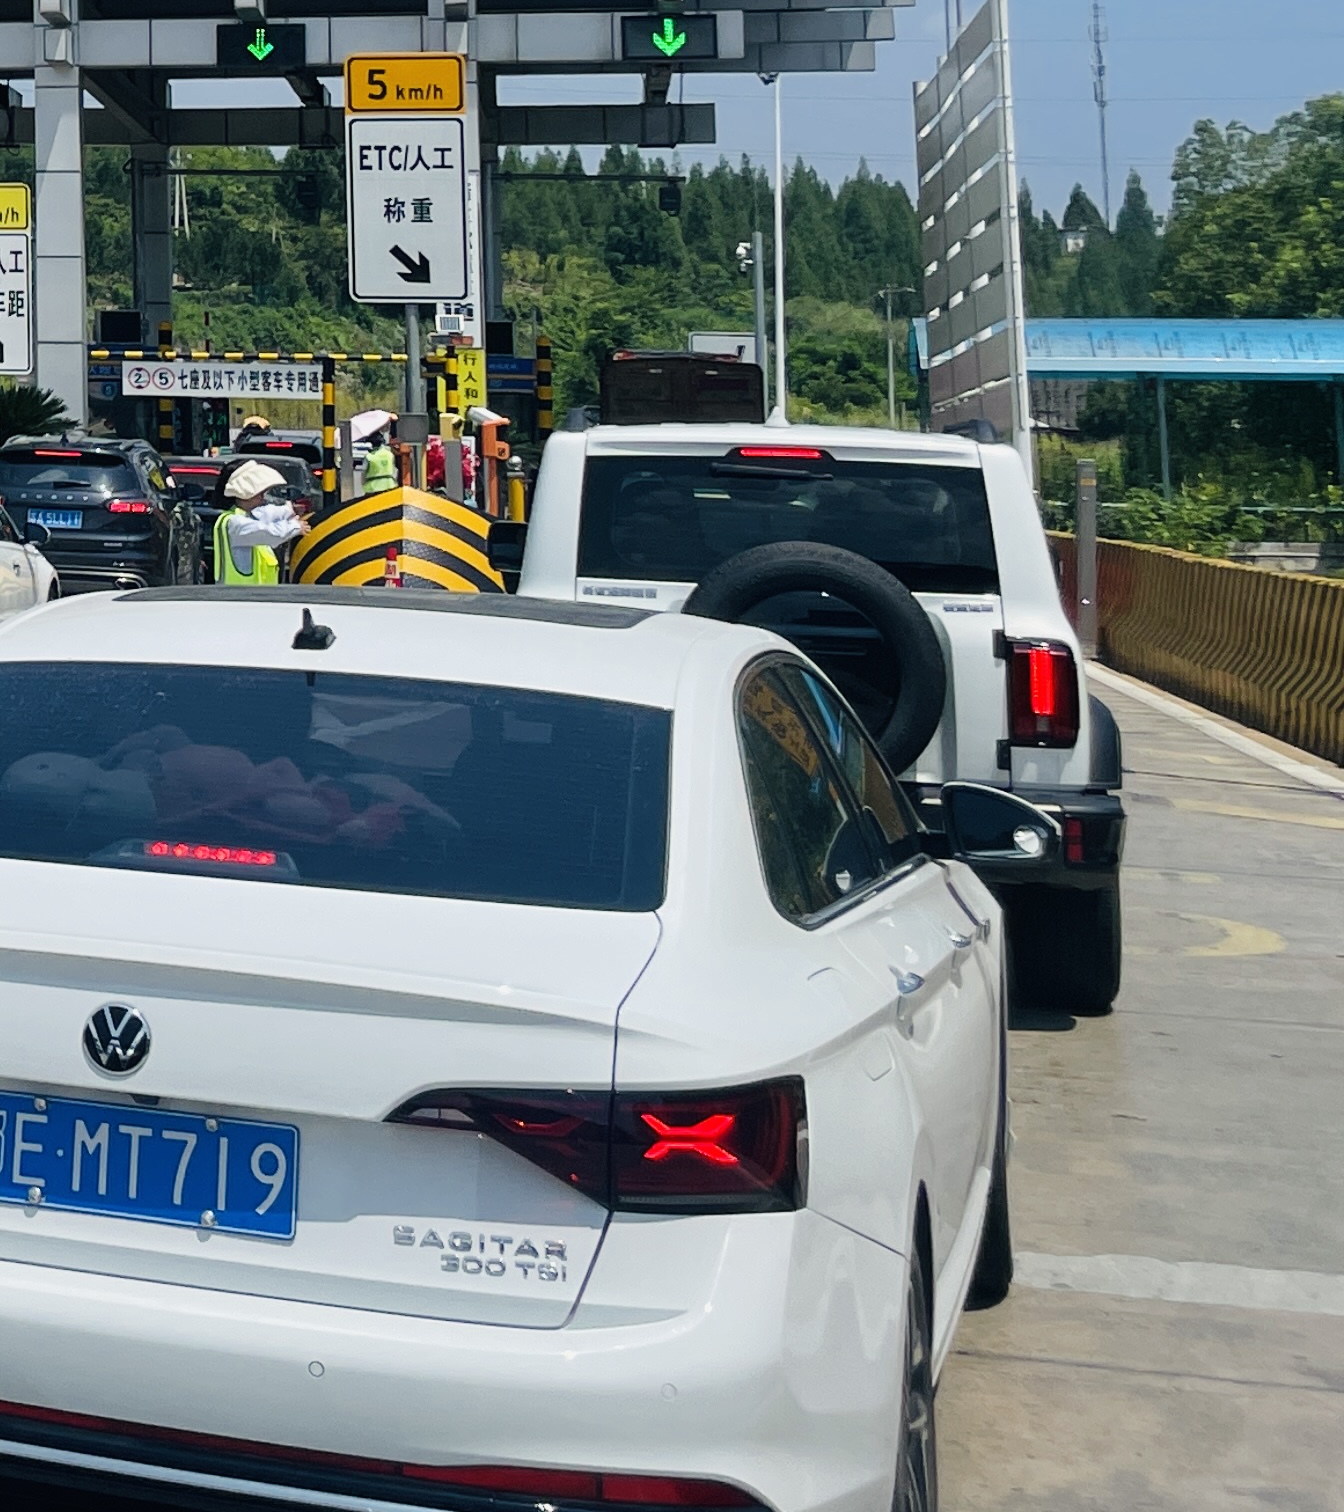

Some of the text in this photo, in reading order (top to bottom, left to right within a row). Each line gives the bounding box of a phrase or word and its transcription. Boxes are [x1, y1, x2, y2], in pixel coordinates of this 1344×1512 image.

[367, 69, 444, 100] 5 km/h
[359, 145, 454, 171] ETC/人工
[383, 197, 433, 223] 称重
[178, 367, 324, 393] 七座及以下小型客车专用通
[463, 353, 478, 407] 行人和
[393, 1225, 568, 1262] SAGITAR
[440, 1254, 567, 1283] 300 TSI
